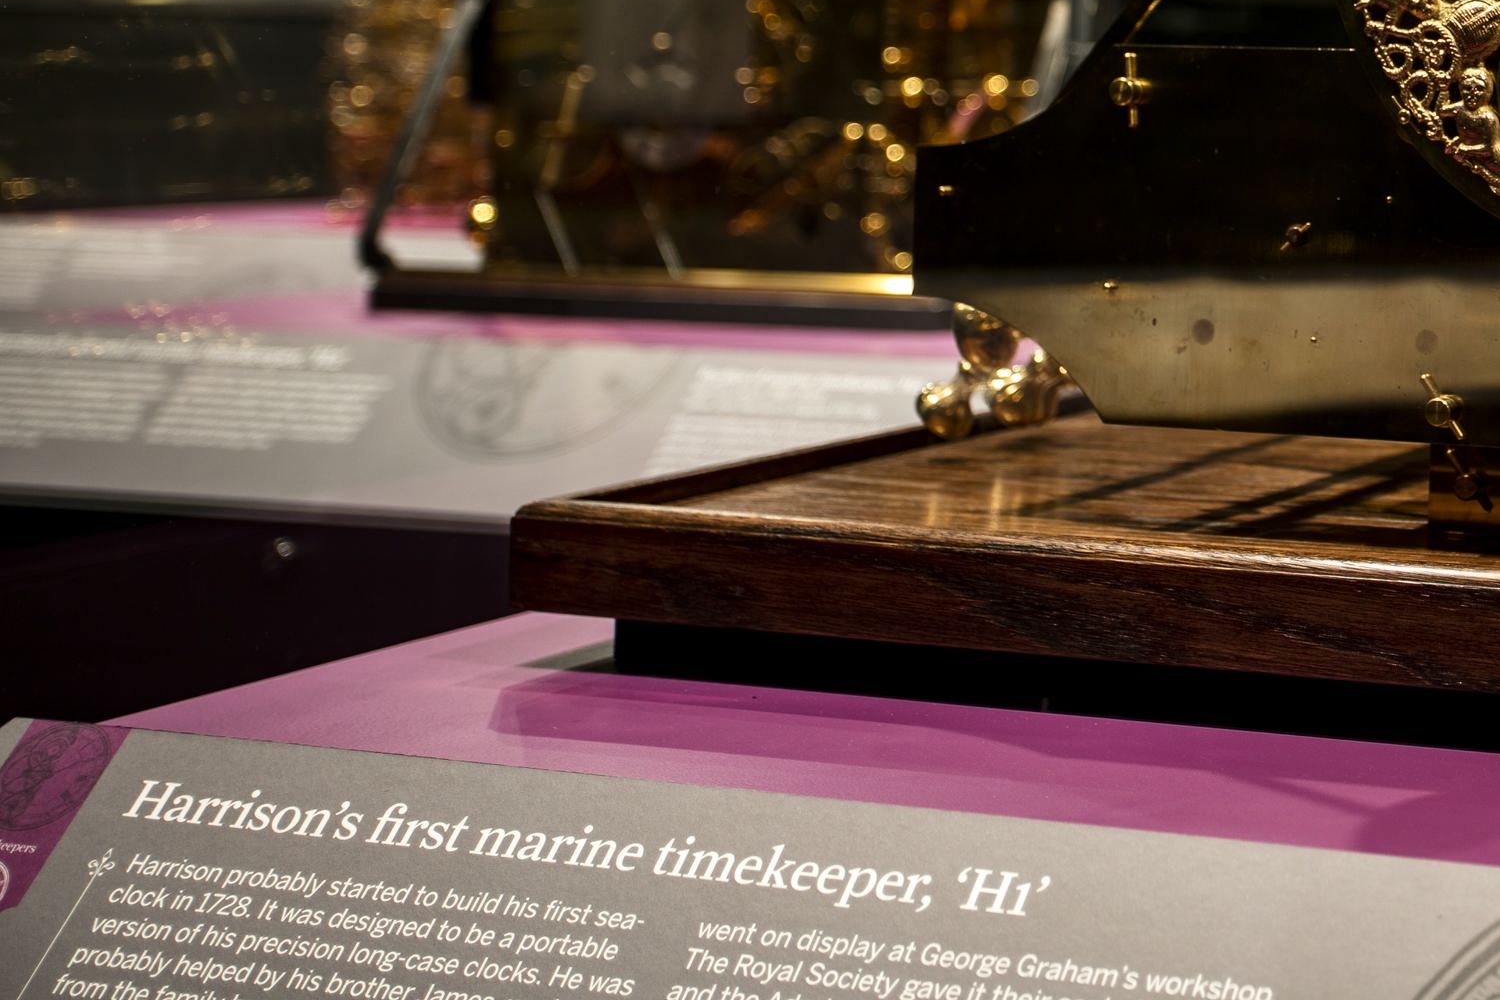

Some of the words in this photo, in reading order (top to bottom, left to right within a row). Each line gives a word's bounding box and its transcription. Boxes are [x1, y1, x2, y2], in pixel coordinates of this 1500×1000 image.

[122, 779, 364, 841] Harrison’s
[365, 802, 469, 852] first
[469, 824, 645, 871] marine
[652, 835, 932, 912] timekeeper,
[108, 884, 168, 908] clock
[170, 890, 194, 911] in
[195, 892, 252, 918] 1728.
[257, 899, 279, 920] It
[281, 907, 326, 926] was
[328, 908, 435, 939] designed
[436, 921, 462, 943] to
[465, 923, 496, 947] be
[498, 932, 516, 949] a
[515, 934, 619, 961] portable
[126, 853, 223, 882] Harrison
[222, 867, 326, 897] probably
[327, 877, 413, 903] started
[413, 886, 438, 907] to
[442, 888, 503, 915] build
[503, 897, 539, 918] his
[543, 900, 592, 925] first
[594, 910, 645, 930] sea-
[52, 973, 108, 999] from
[111, 981, 149, 1000] the
[155, 985, 227, 1000] fam
[67, 946, 173, 978] probably
[173, 954, 255, 983] helped
[253, 963, 286, 992] by
[286, 967, 322, 992] his
[325, 971, 417, 1000] brother
[420, 983, 496, 1000] Jam
[91, 917, 172, 941] version
[174, 922, 204, 944] of
[200, 925, 237, 948] his
[236, 934, 345, 962] precision
[347, 941, 460, 975] long-case
[463, 956, 542, 985] clocks.
[548, 965, 584, 990] He
[588, 975, 636, 997] was
[666, 984, 718, 1000] and
[685, 947, 729, 974] The
[733, 953, 803, 985] Royal
[805, 961, 899, 999] Society
[899, 978, 961, 1000] gave
[967, 981, 987, 1000] it
[991, 985, 1053, 1000] thi
[698, 921, 757, 945] went
[760, 929, 792, 949] on
[797, 929, 885, 964] display
[888, 941, 916, 963] at
[920, 942, 1011, 977] George
[1017, 953, 1140, 990] Graham's
[1146, 973, 1274, 1000] workshop
